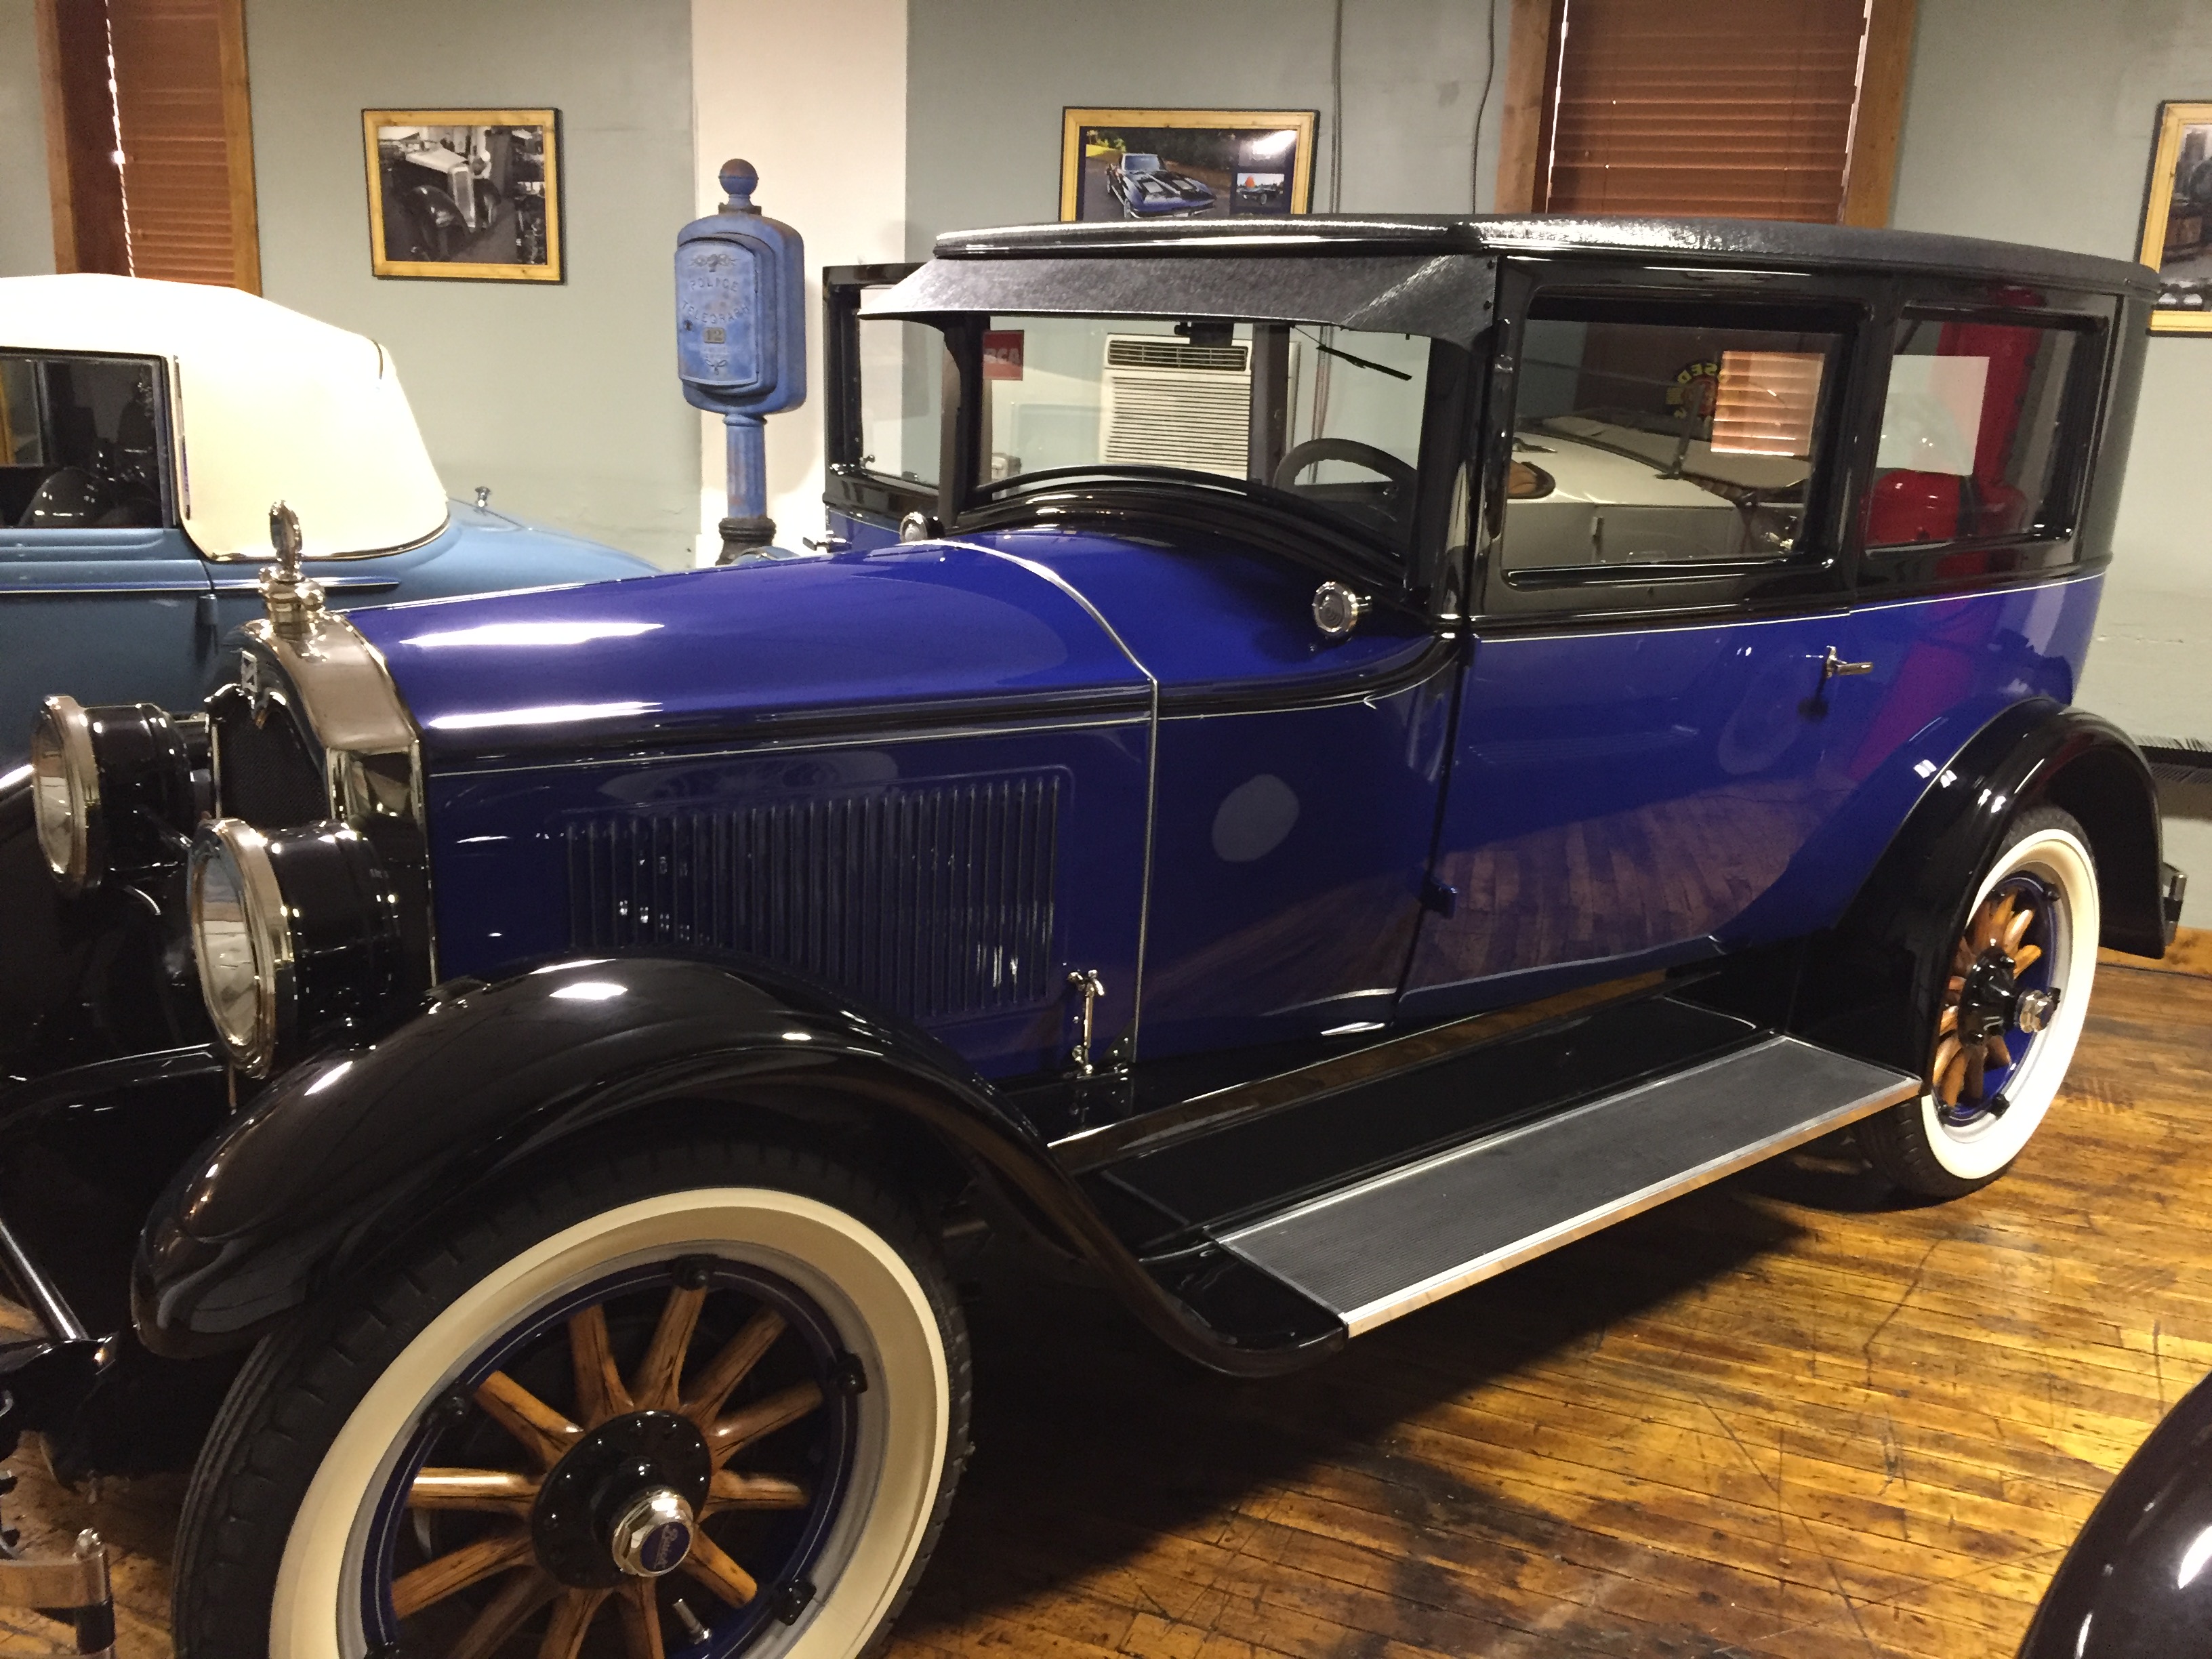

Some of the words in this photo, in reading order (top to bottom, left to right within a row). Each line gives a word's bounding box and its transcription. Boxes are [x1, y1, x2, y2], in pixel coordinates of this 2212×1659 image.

[689, 276, 739, 292] POLICE
[682, 300, 750, 324] TELEGRAPH
[706, 329, 722, 341] 12
